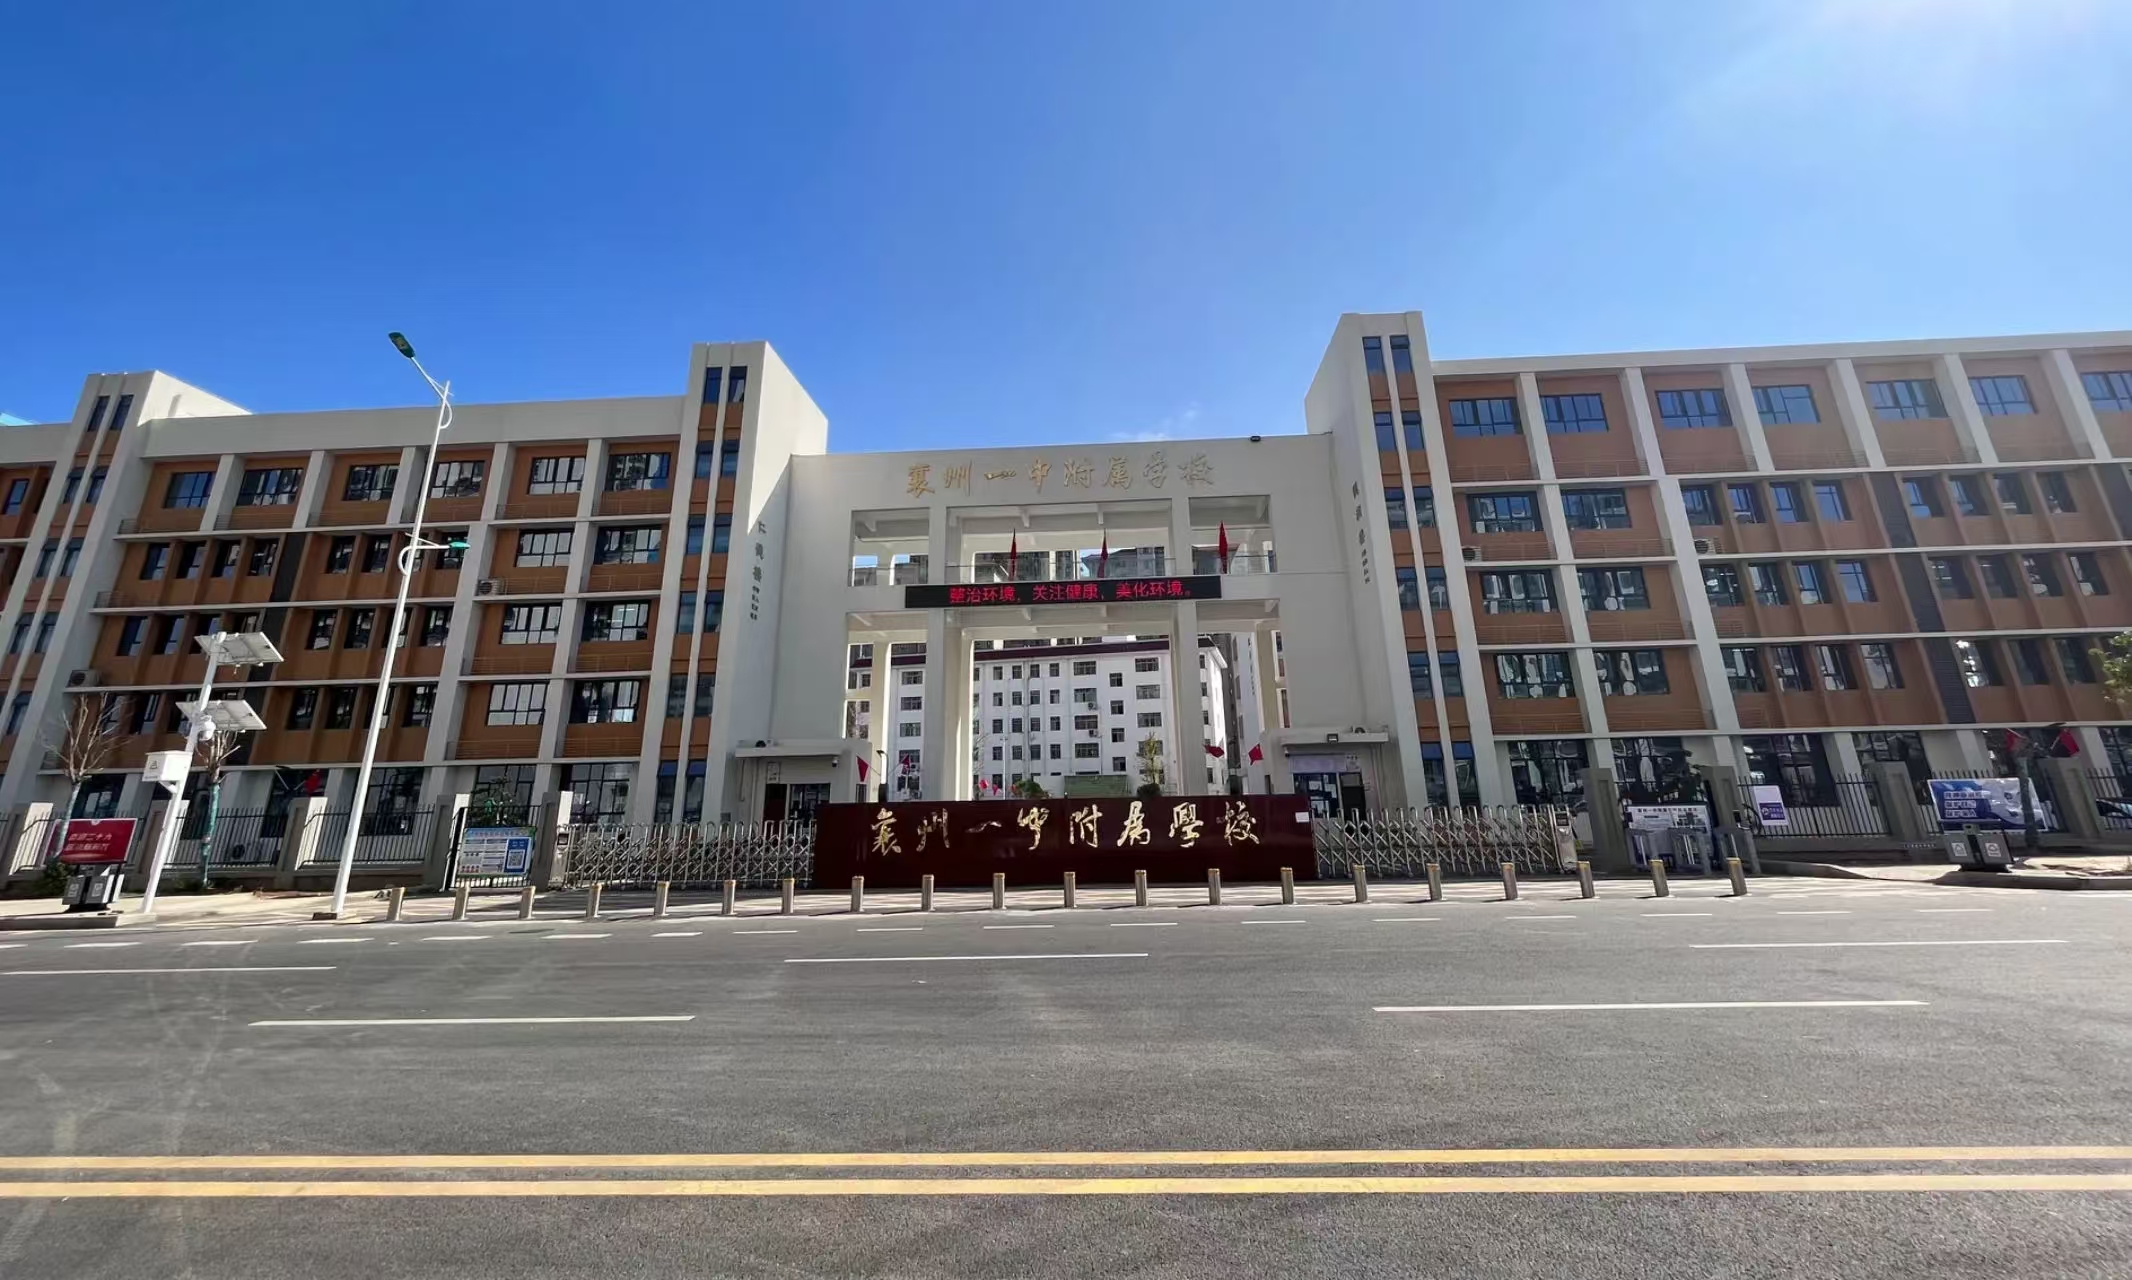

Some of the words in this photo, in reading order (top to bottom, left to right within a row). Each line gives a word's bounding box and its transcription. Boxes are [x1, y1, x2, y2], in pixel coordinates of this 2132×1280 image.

[906, 450, 1215, 499] 襄州一中附属学校
